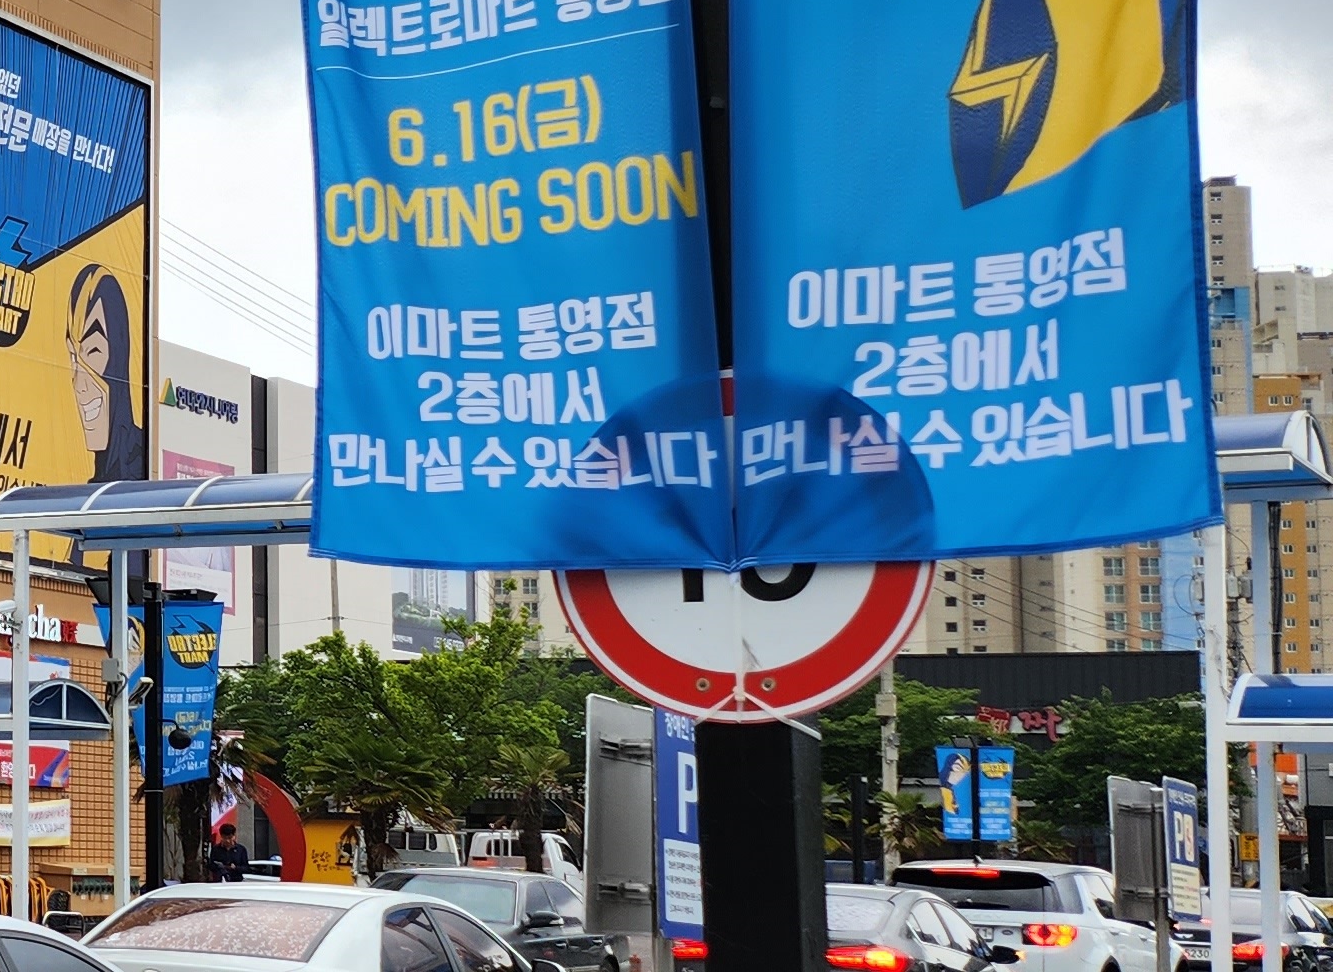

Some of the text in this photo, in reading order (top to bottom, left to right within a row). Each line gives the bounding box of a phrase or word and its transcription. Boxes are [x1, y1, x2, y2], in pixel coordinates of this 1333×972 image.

[32, 116, 72, 156] 매장을
[388, 74, 602, 168] 6.16(금)
[324, 150, 699, 248] COMING SOON
[787, 227, 1127, 329] 이마트 통영점
[367, 290, 658, 360] 이마트 통영점
[852, 318, 1060, 398] 2층에서
[418, 366, 606, 426] 2층에서
[742, 379, 1194, 487] 만나실 수 있습니다
[329, 430, 720, 493] 만나실 수 있습니다
[677, 750, 698, 834] P
